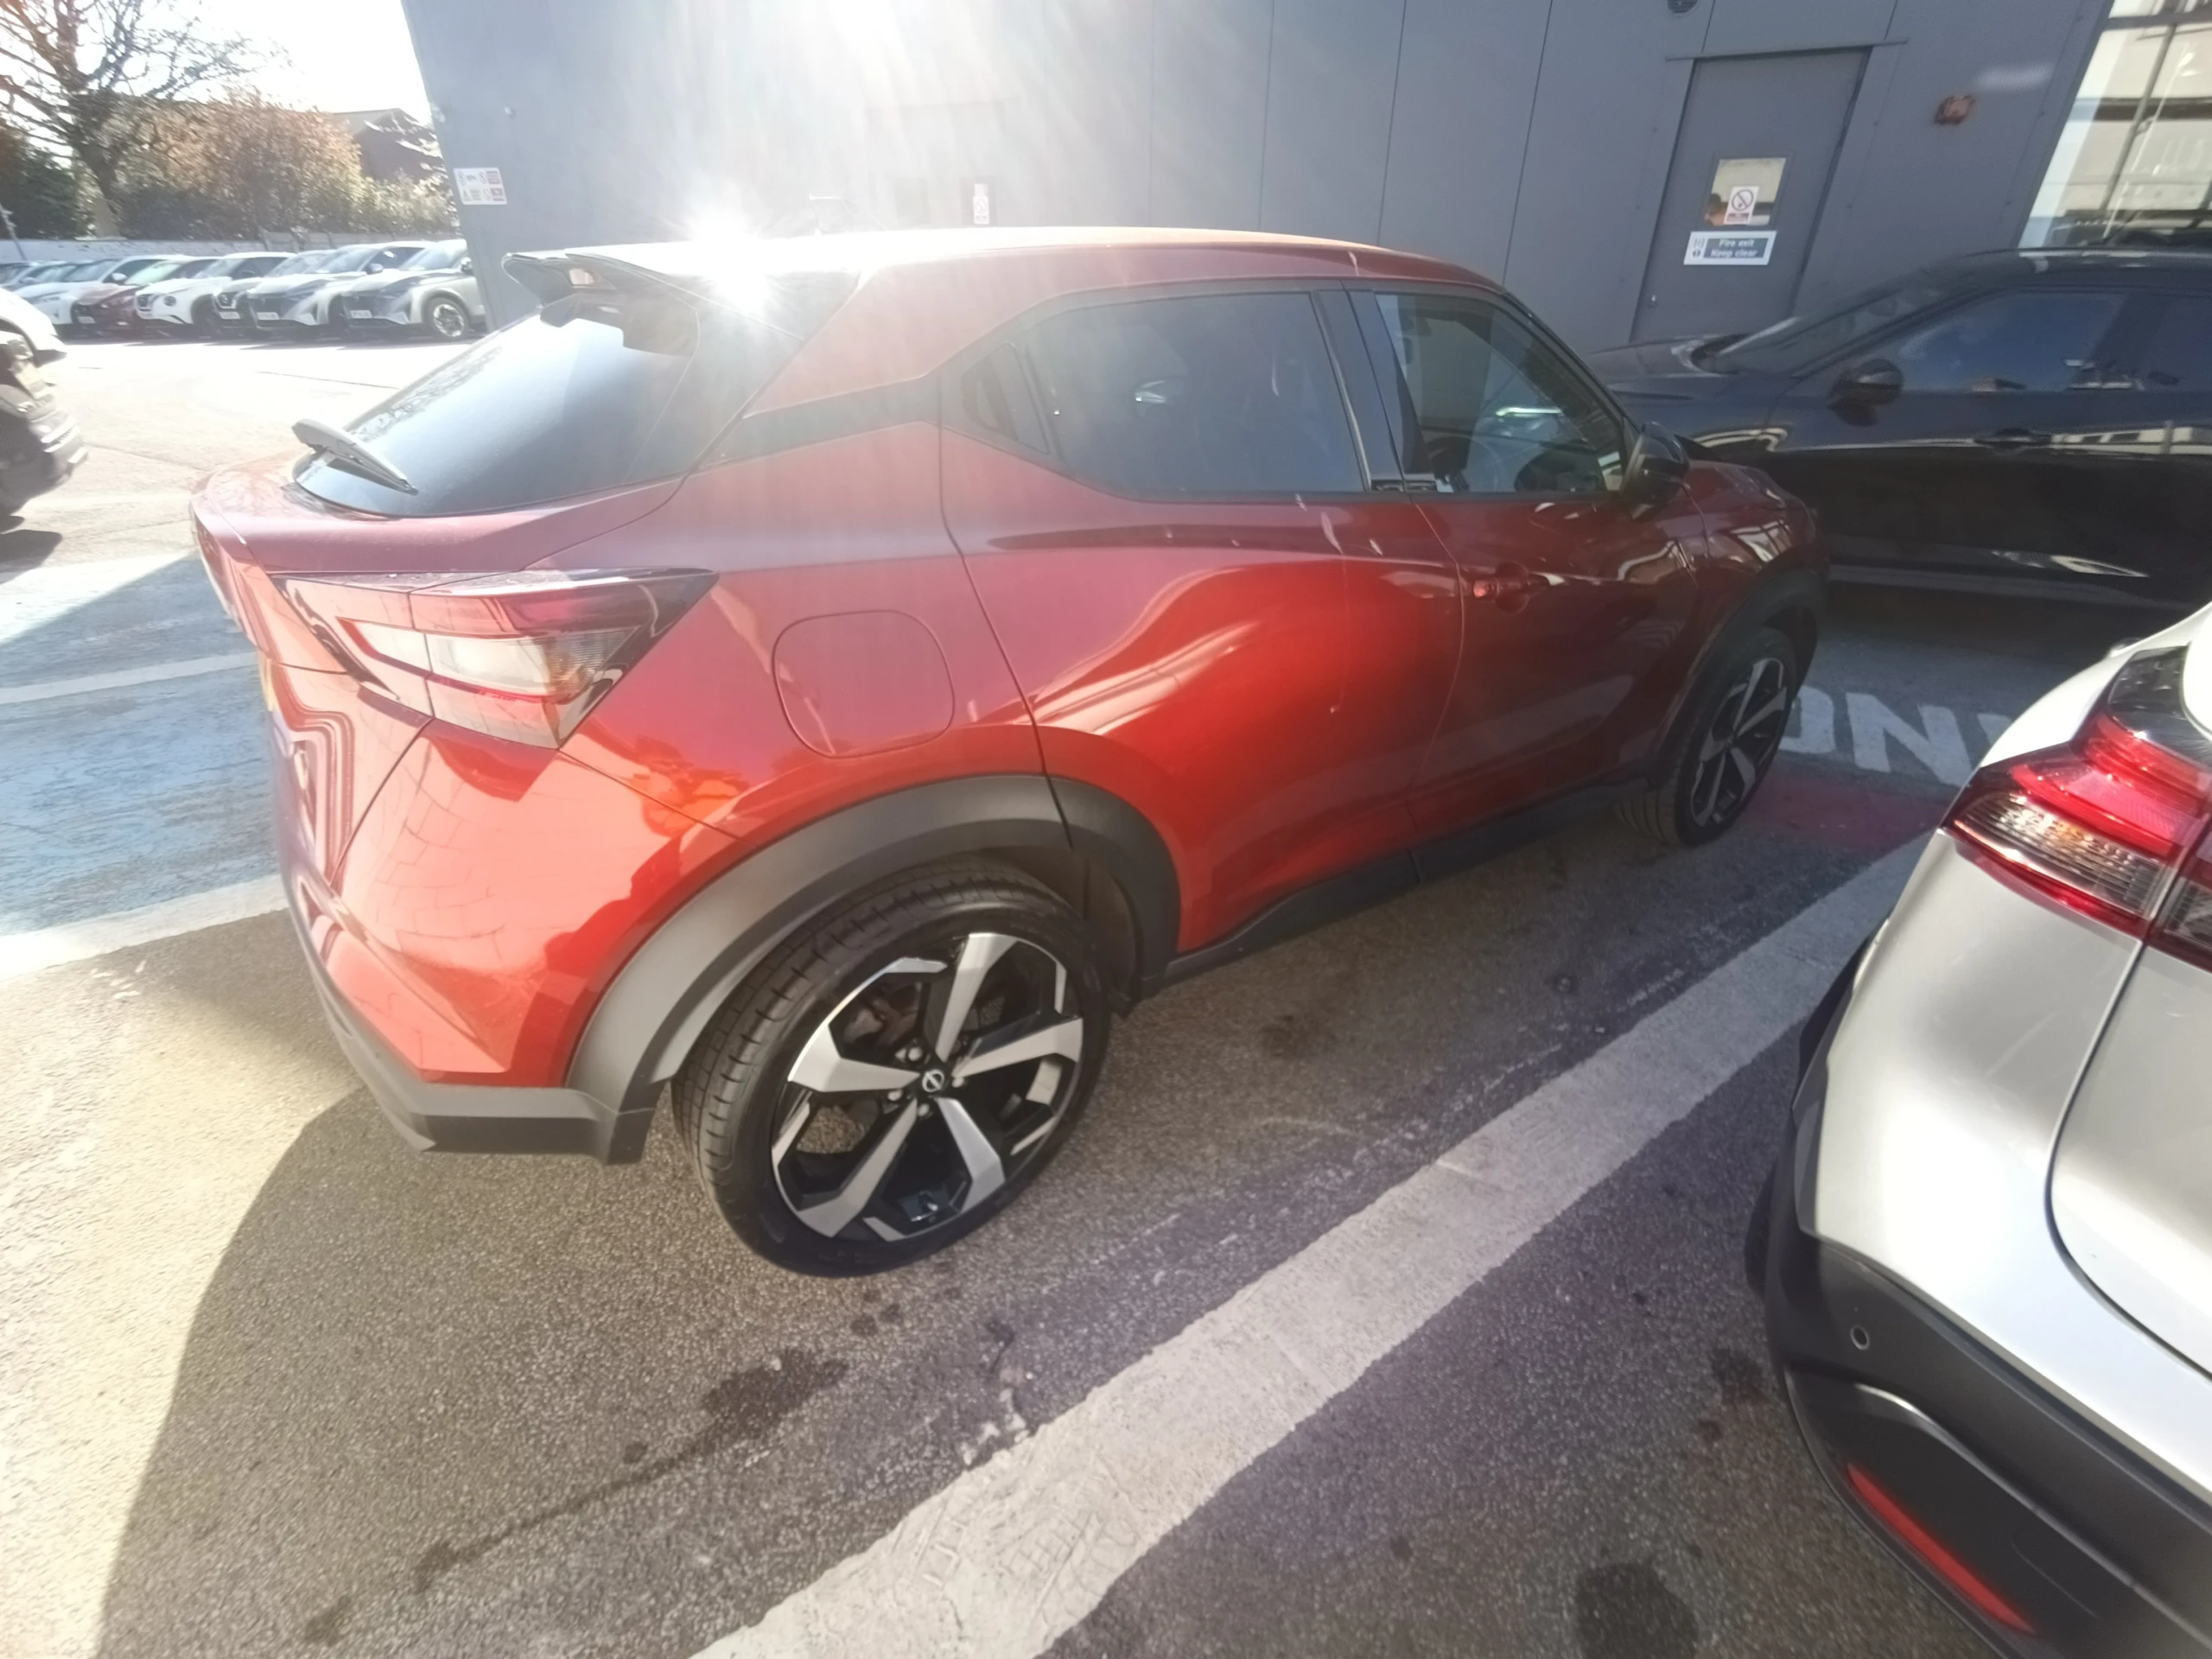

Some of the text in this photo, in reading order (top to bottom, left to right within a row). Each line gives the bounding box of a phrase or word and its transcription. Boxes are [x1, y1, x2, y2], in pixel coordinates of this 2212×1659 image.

[1719, 238, 1736, 247] Fire
[1711, 248, 1758, 258] Keep clear
